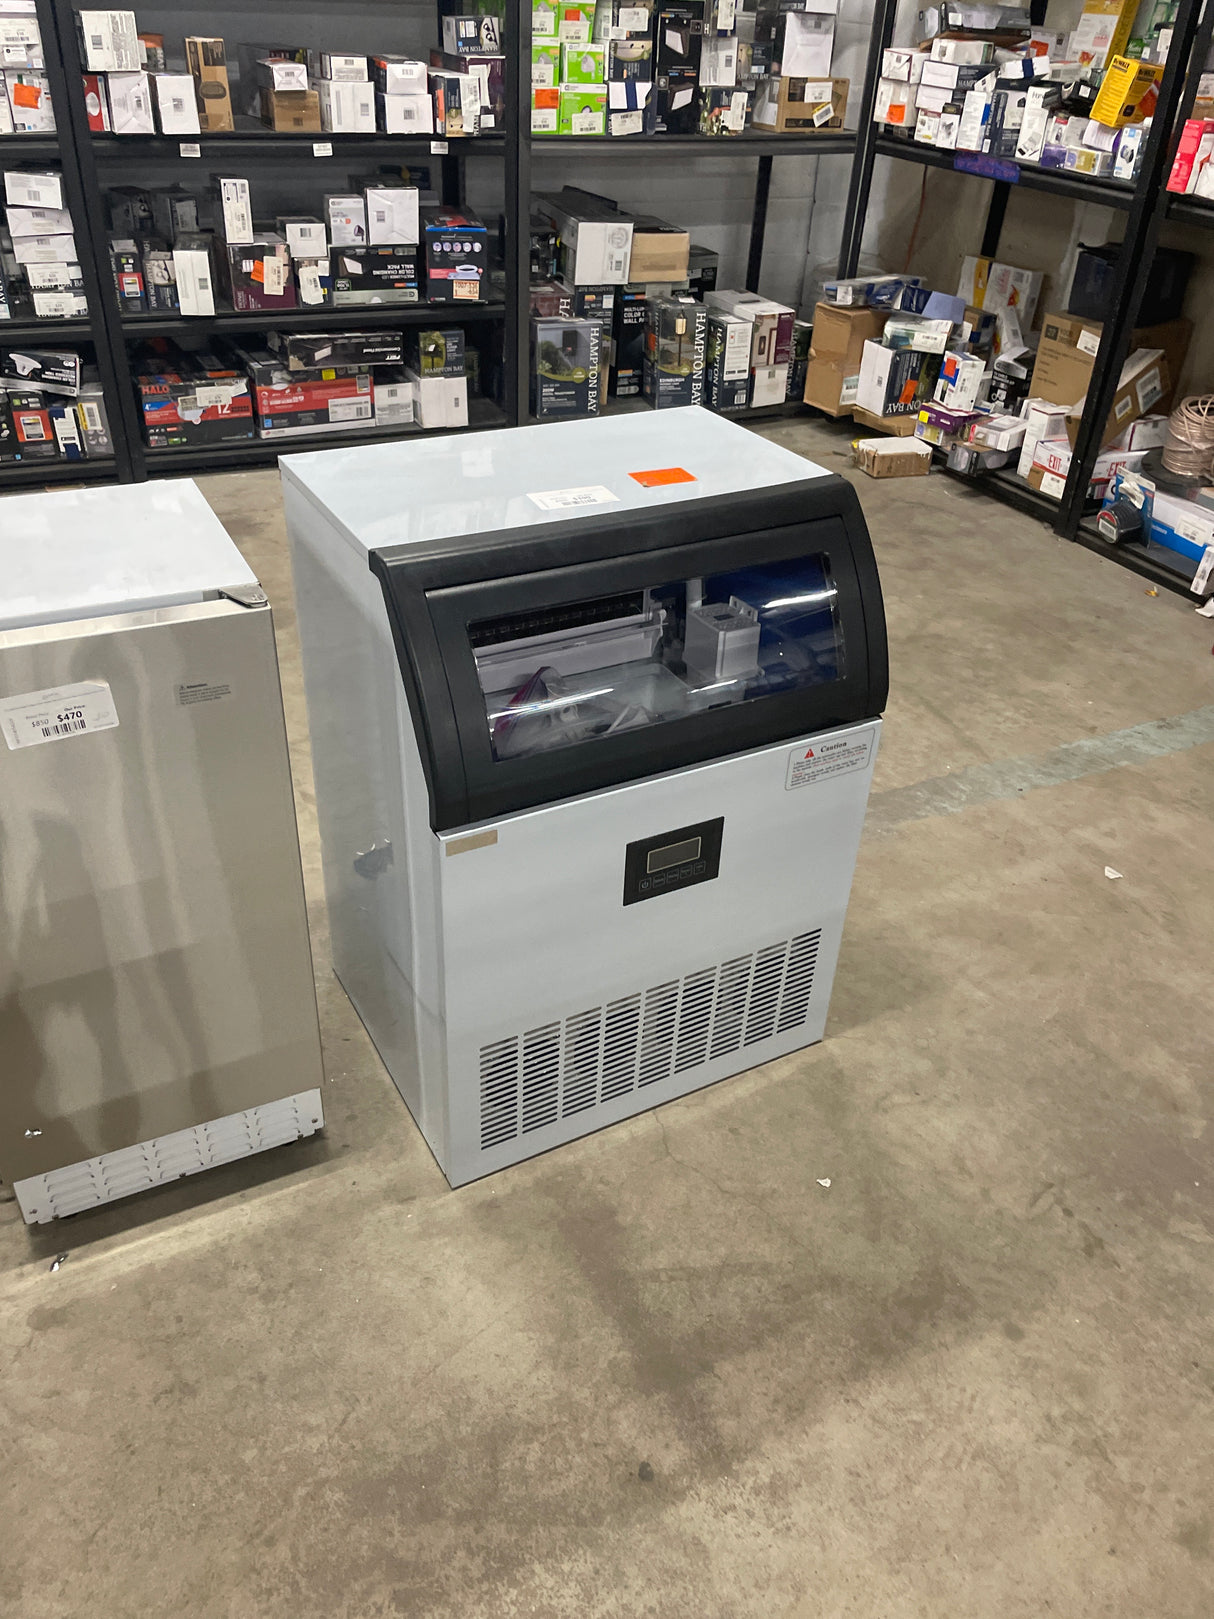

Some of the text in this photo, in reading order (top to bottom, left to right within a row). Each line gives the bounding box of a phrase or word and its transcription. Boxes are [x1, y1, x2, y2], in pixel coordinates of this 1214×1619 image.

[691, 312, 706, 405] HAMPTON BAY
[713, 327, 723, 385] HAMPTON
[424, 366, 452, 374] HAMPTON
[587, 327, 600, 412] HAMPTON BAY
[141, 385, 170, 395] HALO
[217, 403, 231, 414] 12
[886, 402, 904, 414] BAY
[1048, 454, 1062, 472] EXIT
[57, 710, 83, 723] $470
[820, 741, 848, 753] Caution
